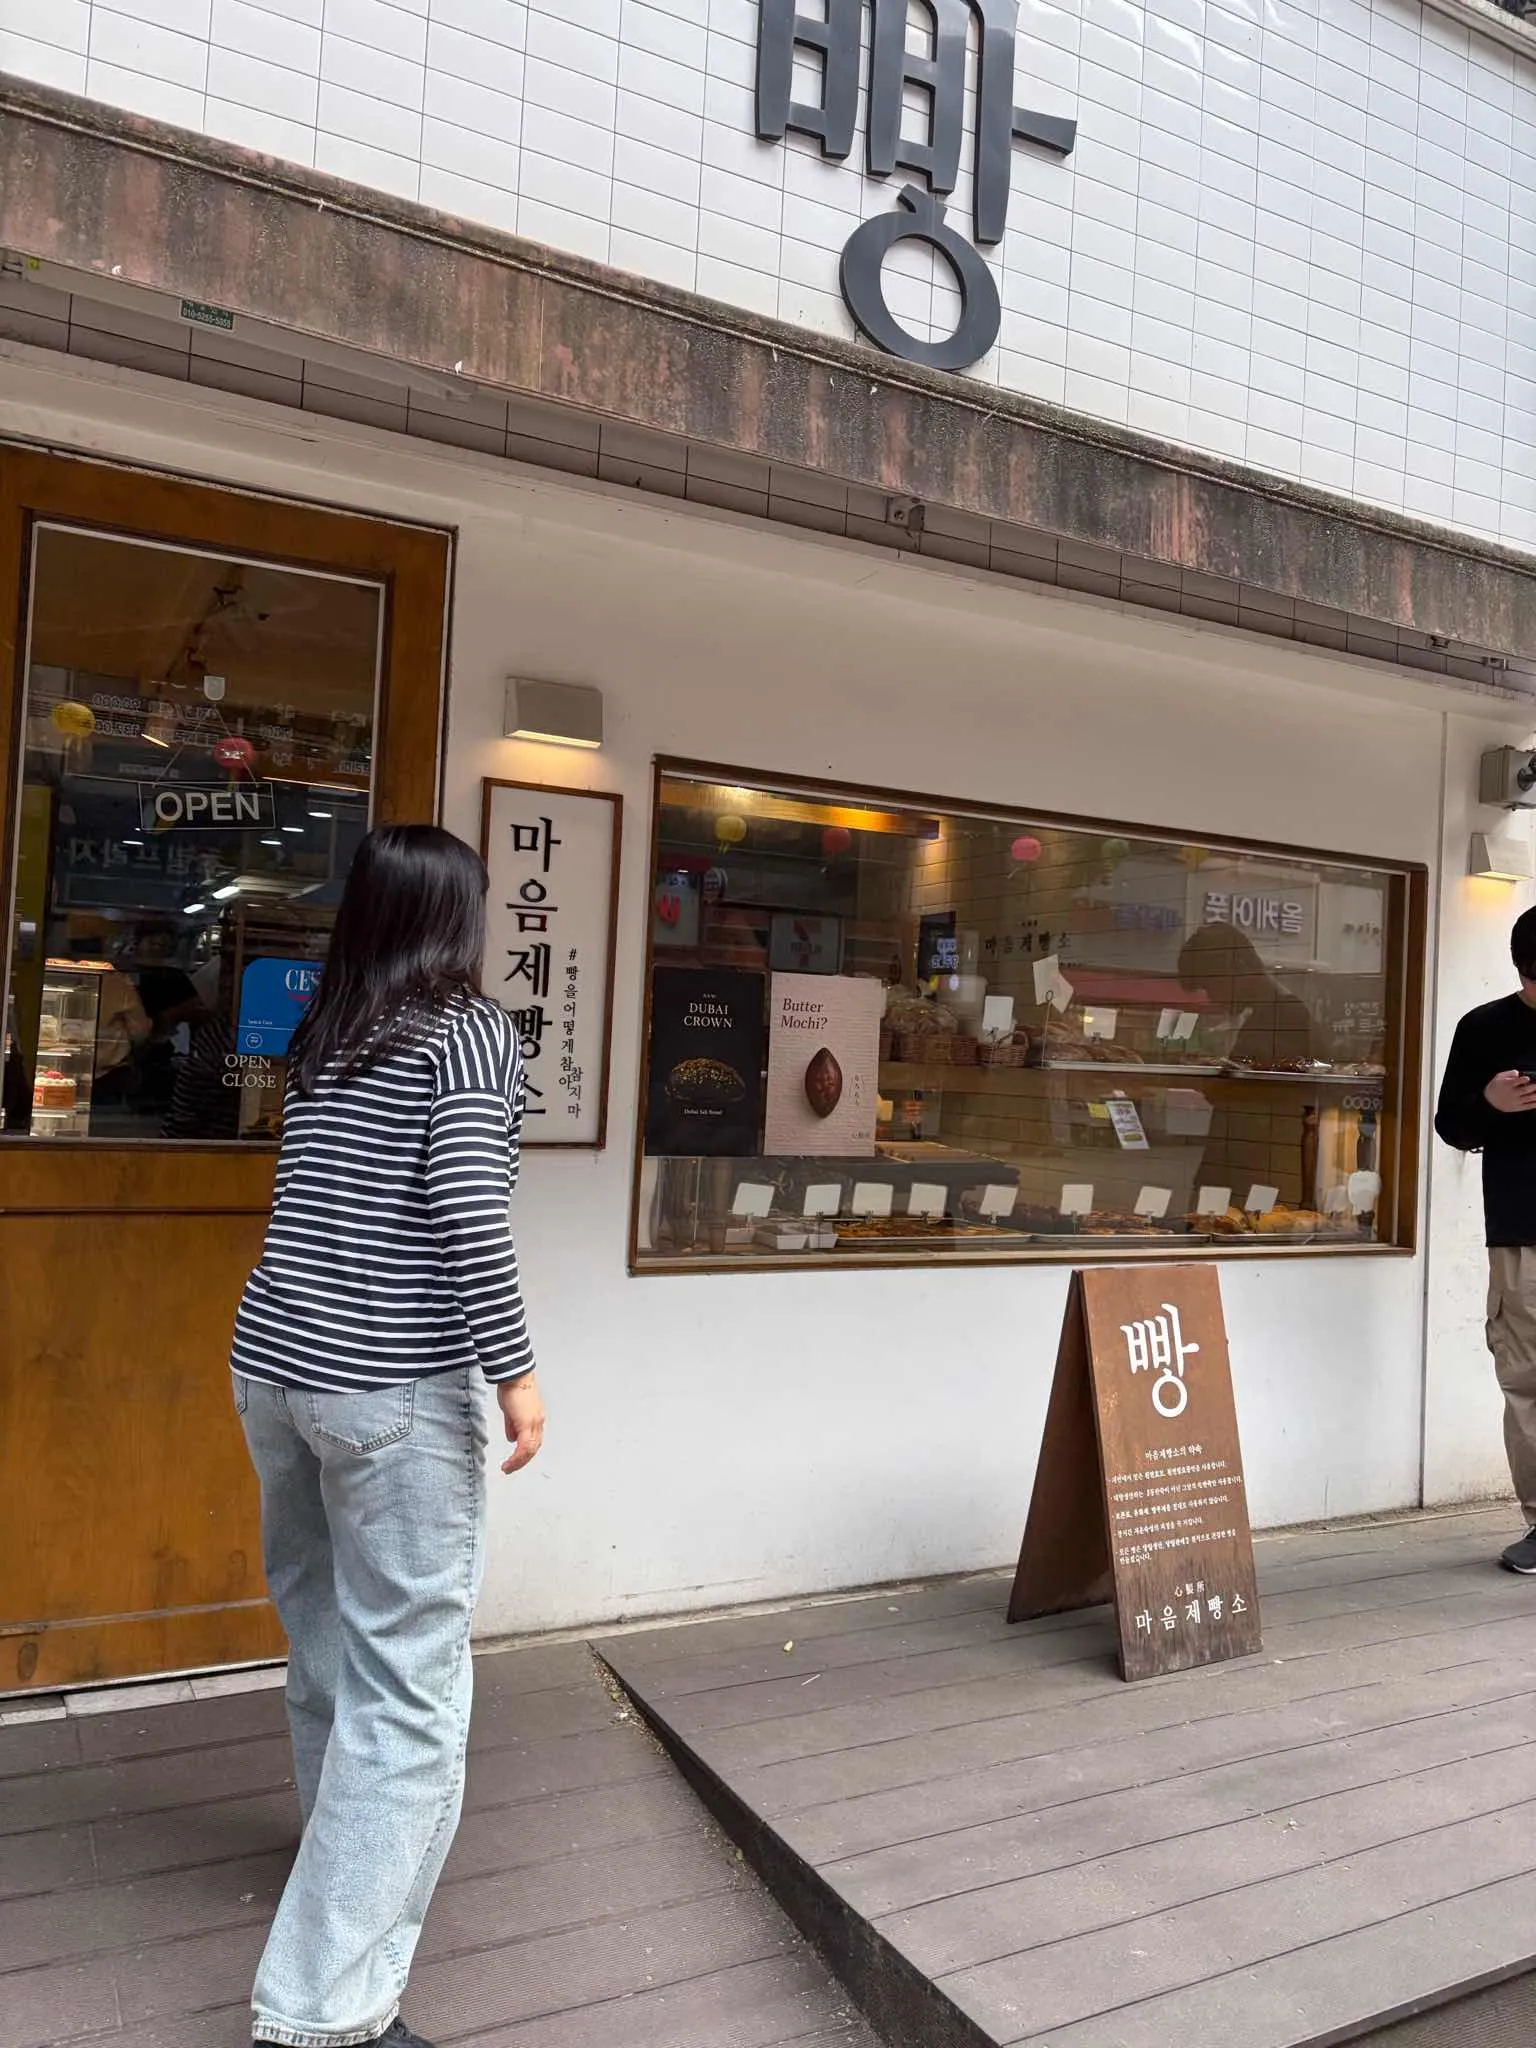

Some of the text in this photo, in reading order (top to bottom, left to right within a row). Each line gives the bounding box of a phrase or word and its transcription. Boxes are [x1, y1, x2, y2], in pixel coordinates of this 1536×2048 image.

[754, 0, 1078, 371] 빵
[154, 791, 261, 822] OPEN
[688, 1002, 729, 1016] DUBAI
[782, 998, 825, 1013] Butter
[683, 1015, 733, 1028] CROWN
[780, 1014, 828, 1030] Mochi?
[224, 1054, 271, 1068] OPEN
[221, 1072, 277, 1089] CLOSE
[1119, 1302, 1200, 1418] 빵
[1135, 1593, 1248, 1635] 마음제빵소
